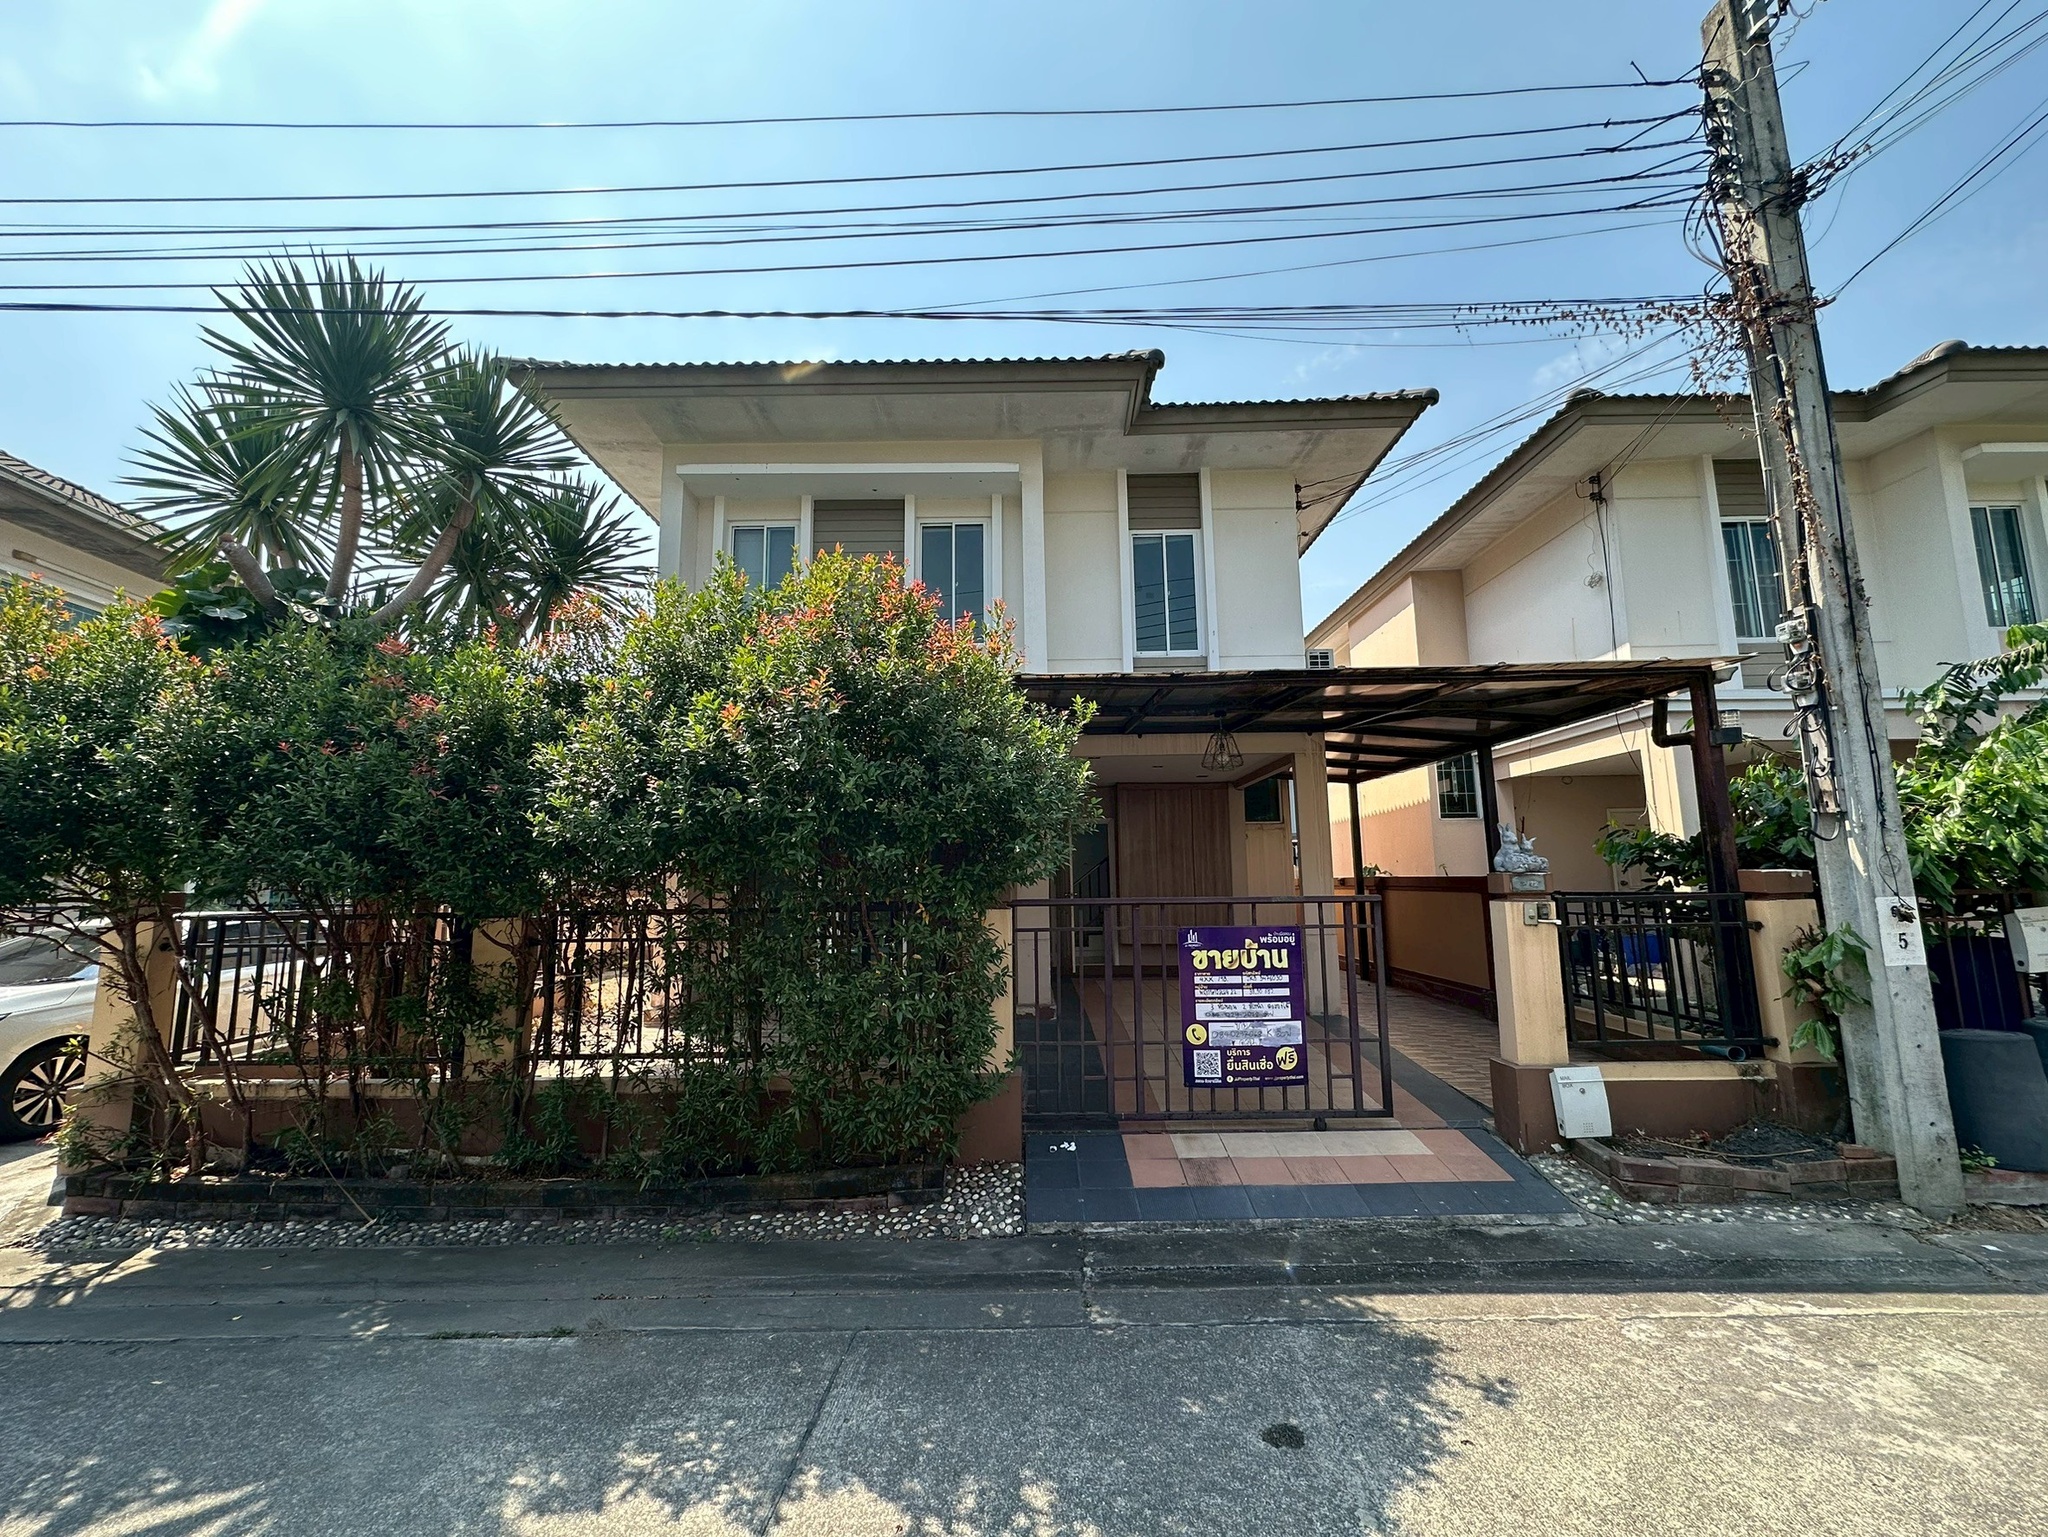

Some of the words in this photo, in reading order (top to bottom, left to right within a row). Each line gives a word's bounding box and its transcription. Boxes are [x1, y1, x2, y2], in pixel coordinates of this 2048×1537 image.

[1259, 933, 1296, 946] พร้อมอยู่
[1899, 932, 1908, 949] 5
[1191, 938, 1289, 970] ขายบ้าน
[1226, 1048, 1251, 1056] บริการ
[1277, 1046, 1296, 1066] ฟรี
[1226, 1056, 1274, 1071] ยื่นสินเชื่อ
